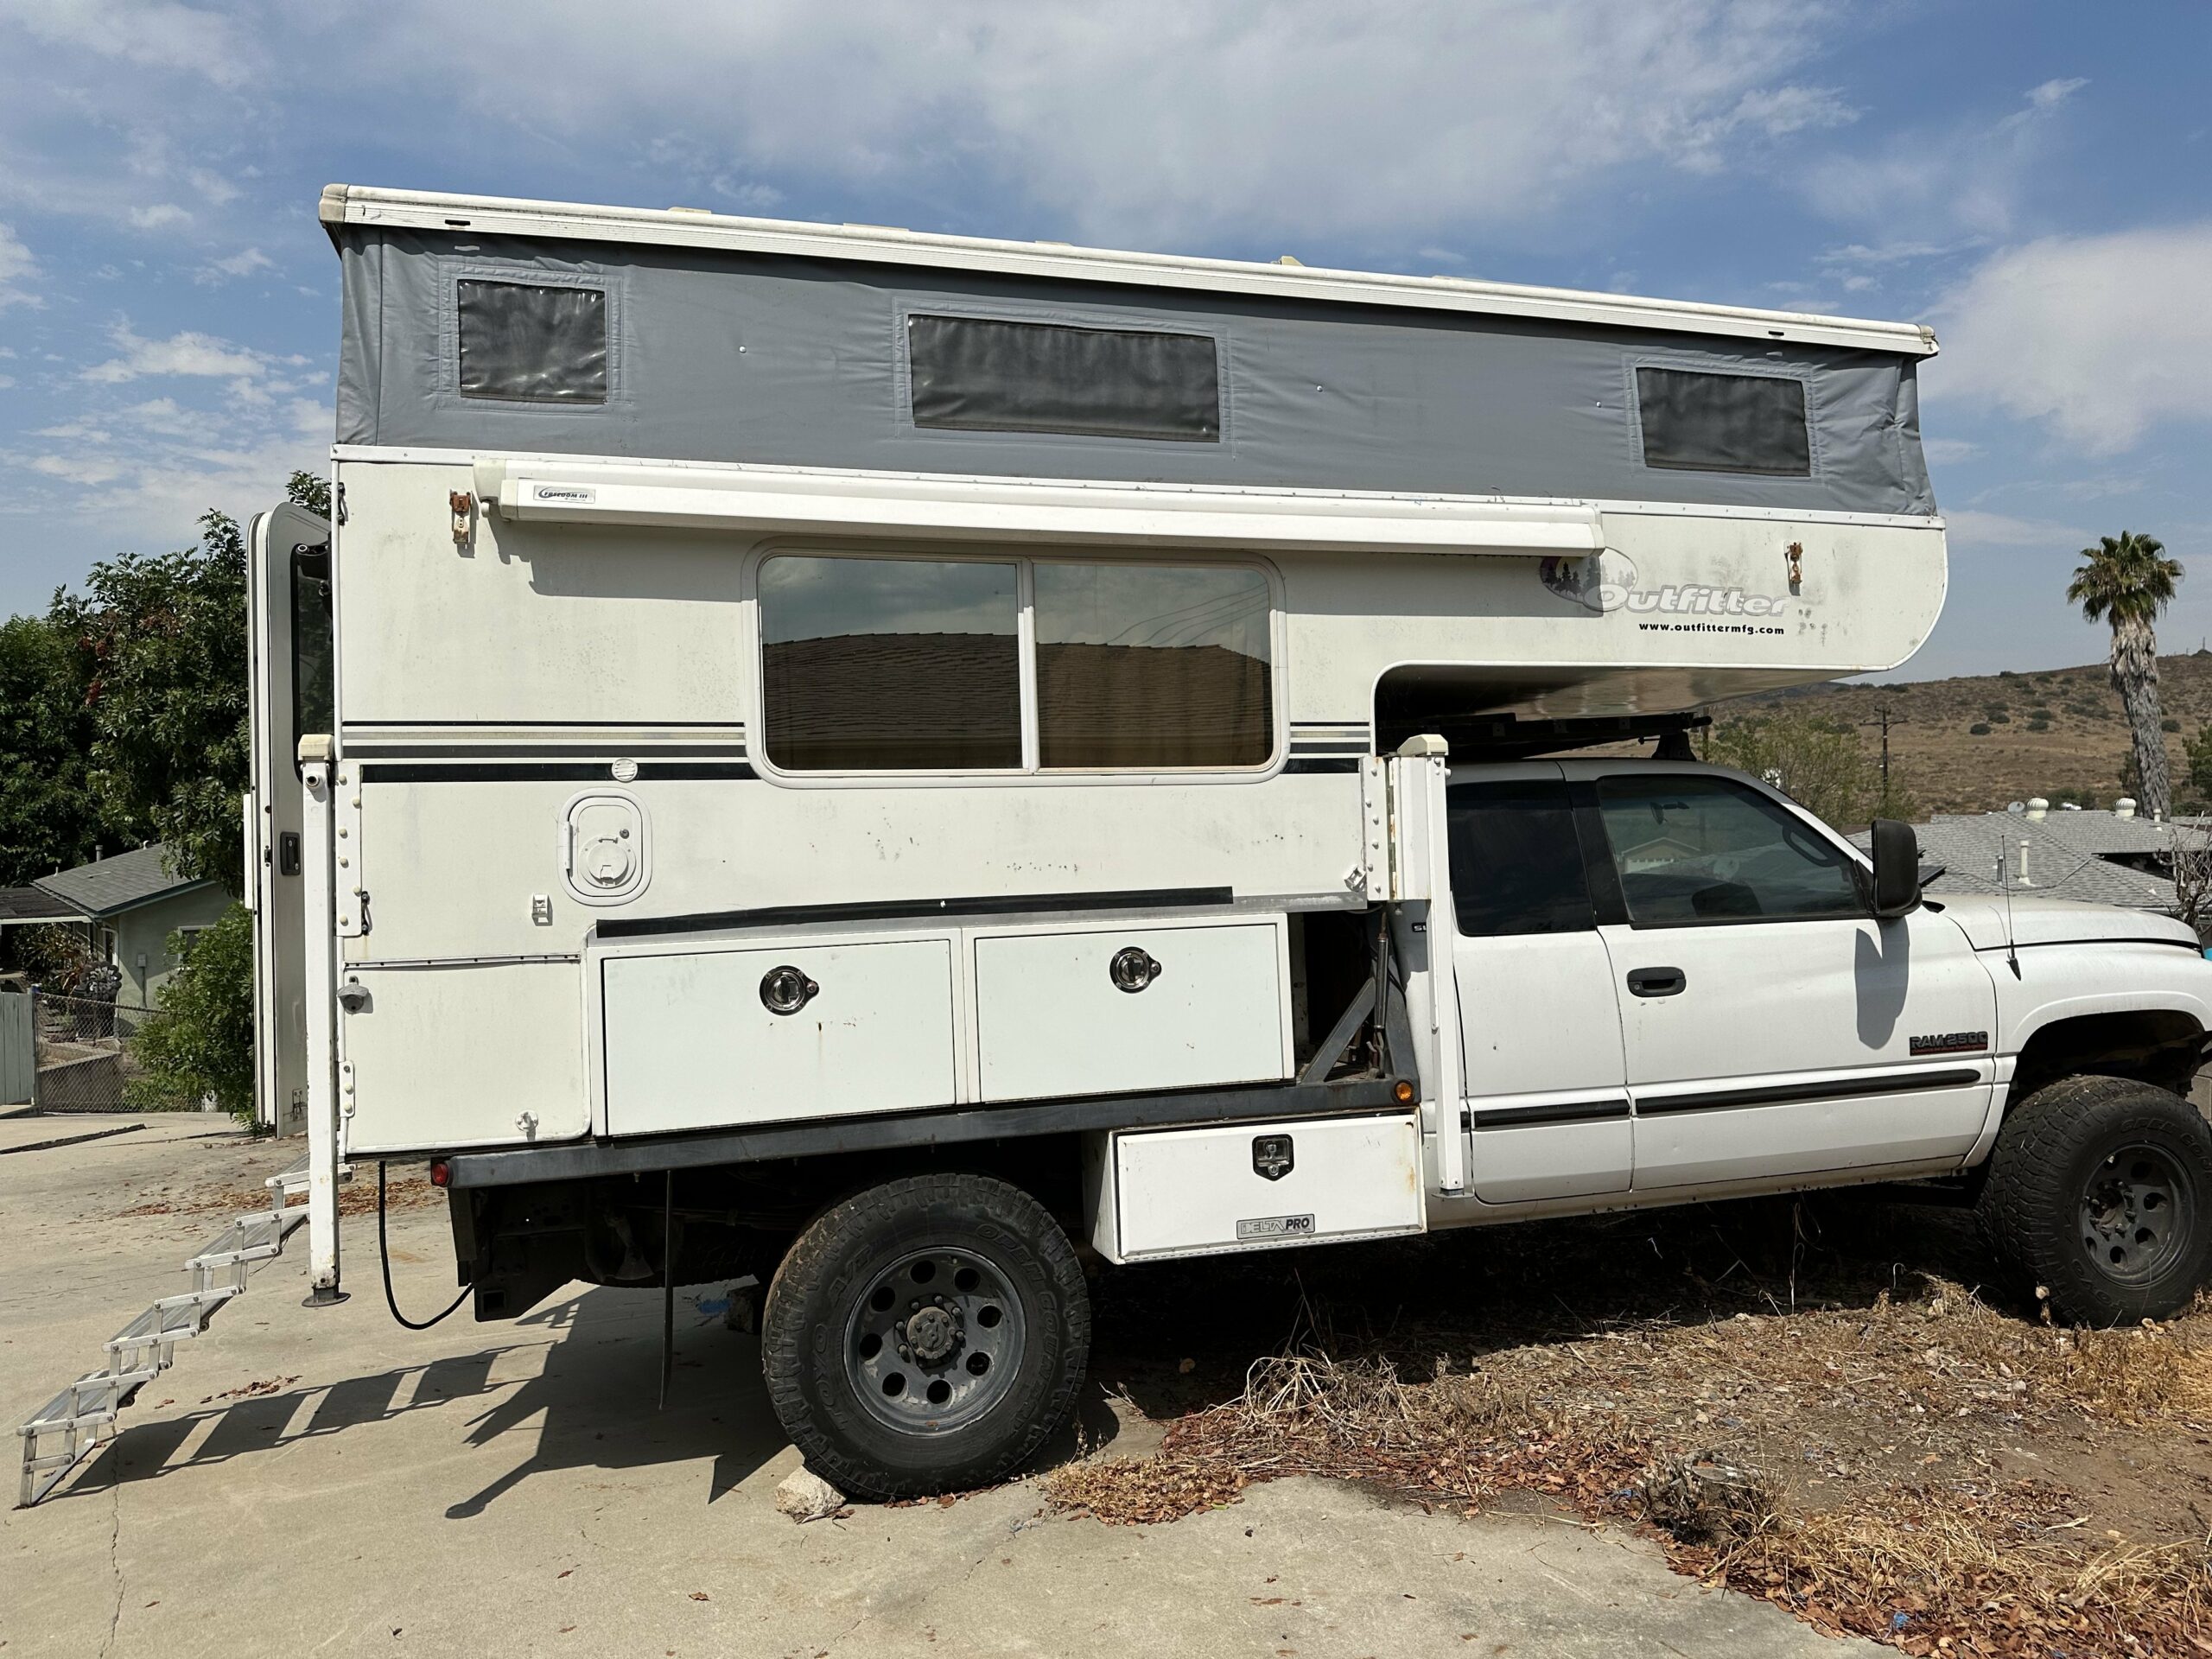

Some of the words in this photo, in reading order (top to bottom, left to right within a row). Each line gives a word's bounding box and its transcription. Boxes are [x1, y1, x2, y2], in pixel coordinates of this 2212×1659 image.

[1582, 583, 1792, 616] Outfitter
[1638, 621, 1785, 636] www.outfittermfg.com
[1910, 1035, 1944, 1048] RAM
[1946, 1032, 1987, 1045] 2500
[1240, 1219, 1286, 1235] DELTA
[1285, 1217, 1311, 1230] PRO
